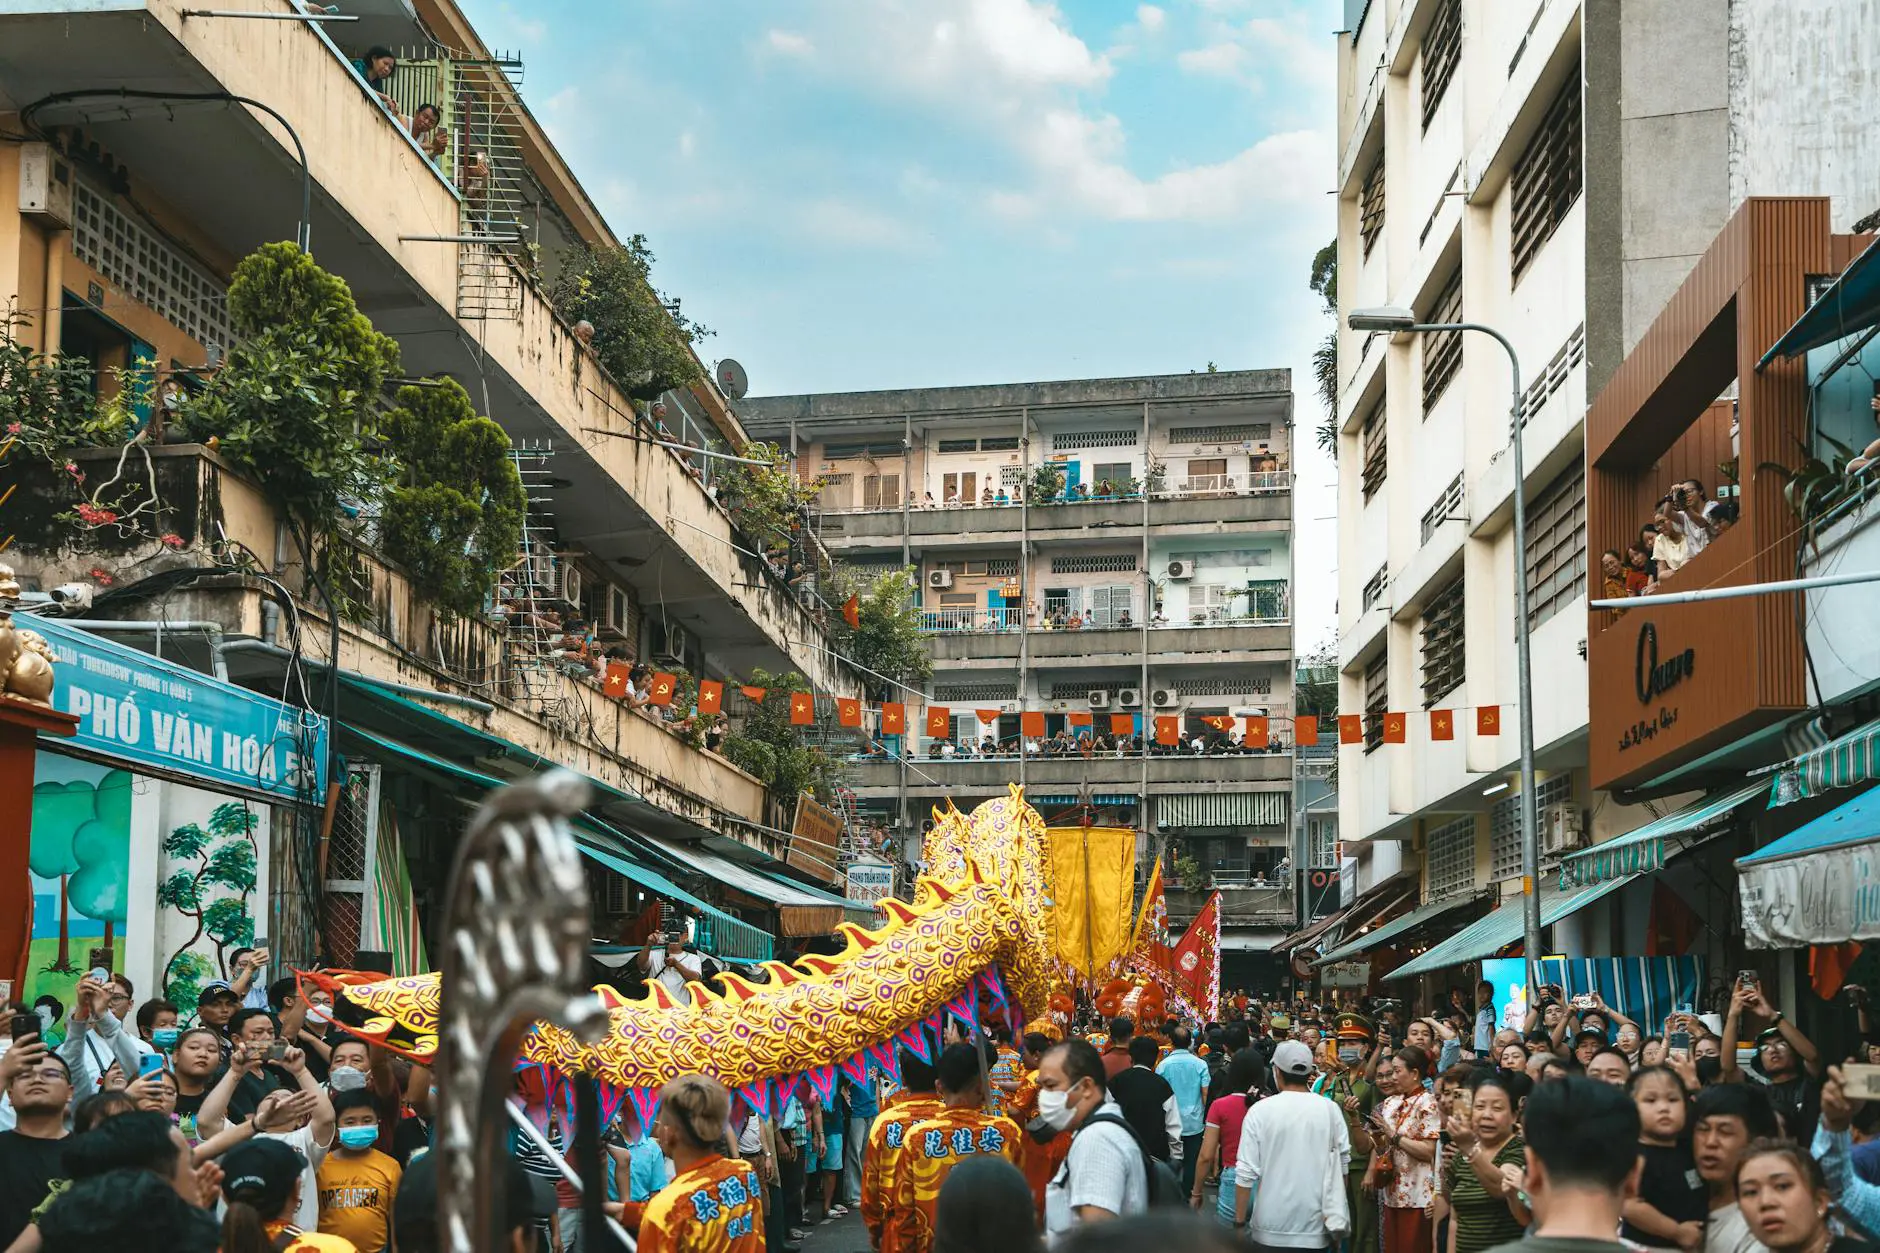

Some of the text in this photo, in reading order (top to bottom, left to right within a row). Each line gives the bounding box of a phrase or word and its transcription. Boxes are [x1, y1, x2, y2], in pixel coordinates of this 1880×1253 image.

[133, 671, 160, 693] PHƯỜNG
[162, 680, 168, 695] 11
[170, 682, 186, 701] QUẬN
[69, 685, 141, 745] PHỐ
[152, 710, 212, 764] VĂN
[223, 731, 277, 781] HÓA
[1300, 871, 1340, 888] OP
[321, 1187, 378, 1209] DREAMER
